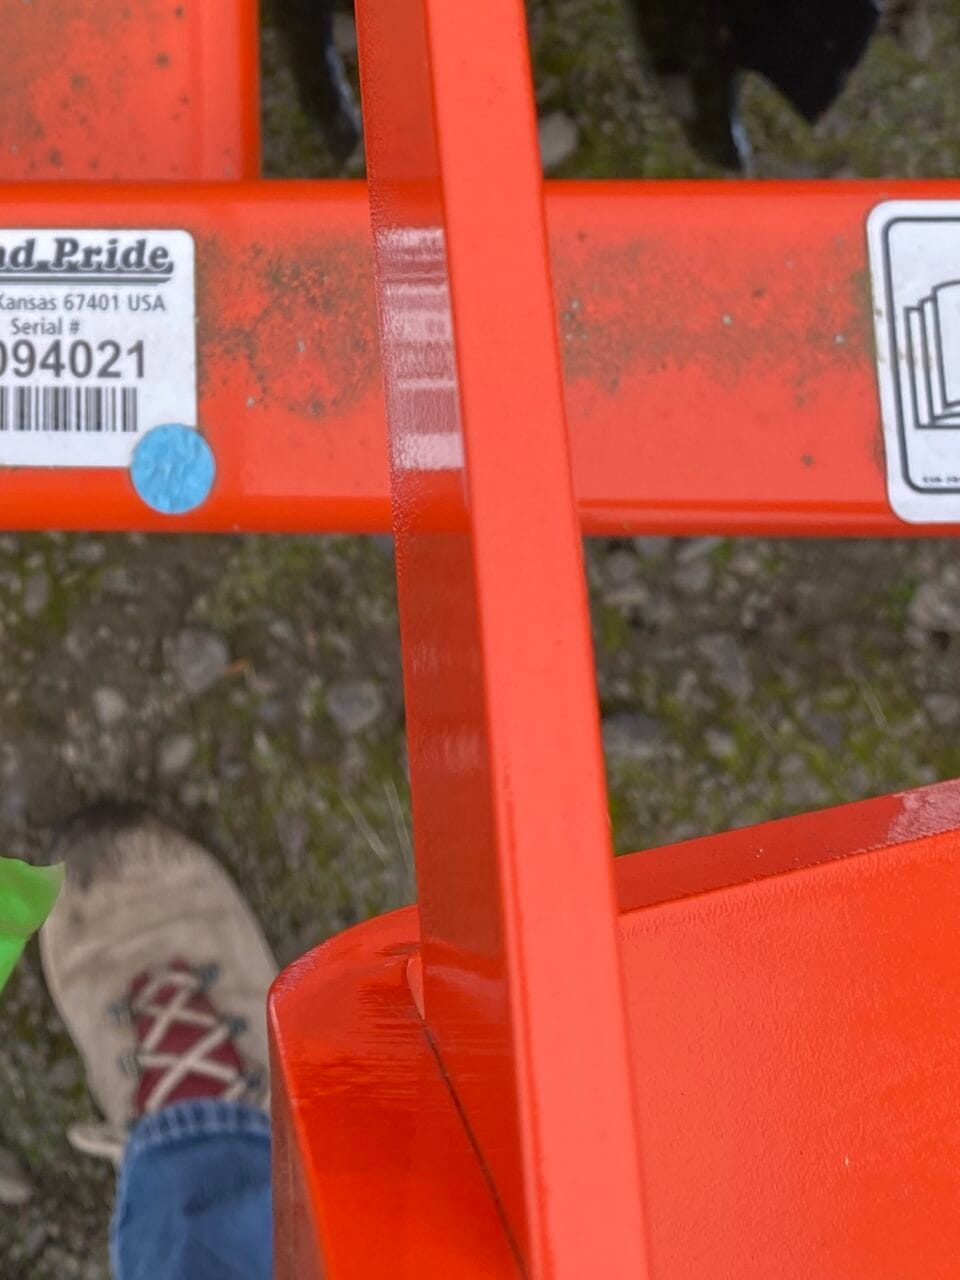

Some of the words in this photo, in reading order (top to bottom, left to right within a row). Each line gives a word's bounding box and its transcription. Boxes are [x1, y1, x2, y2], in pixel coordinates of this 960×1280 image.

[52, 238, 171, 270] Pride
[63, 294, 120, 312] 67401
[128, 294, 166, 312] USA
[10, 317, 63, 335] Serial
[69, 320, 81, 335] #
